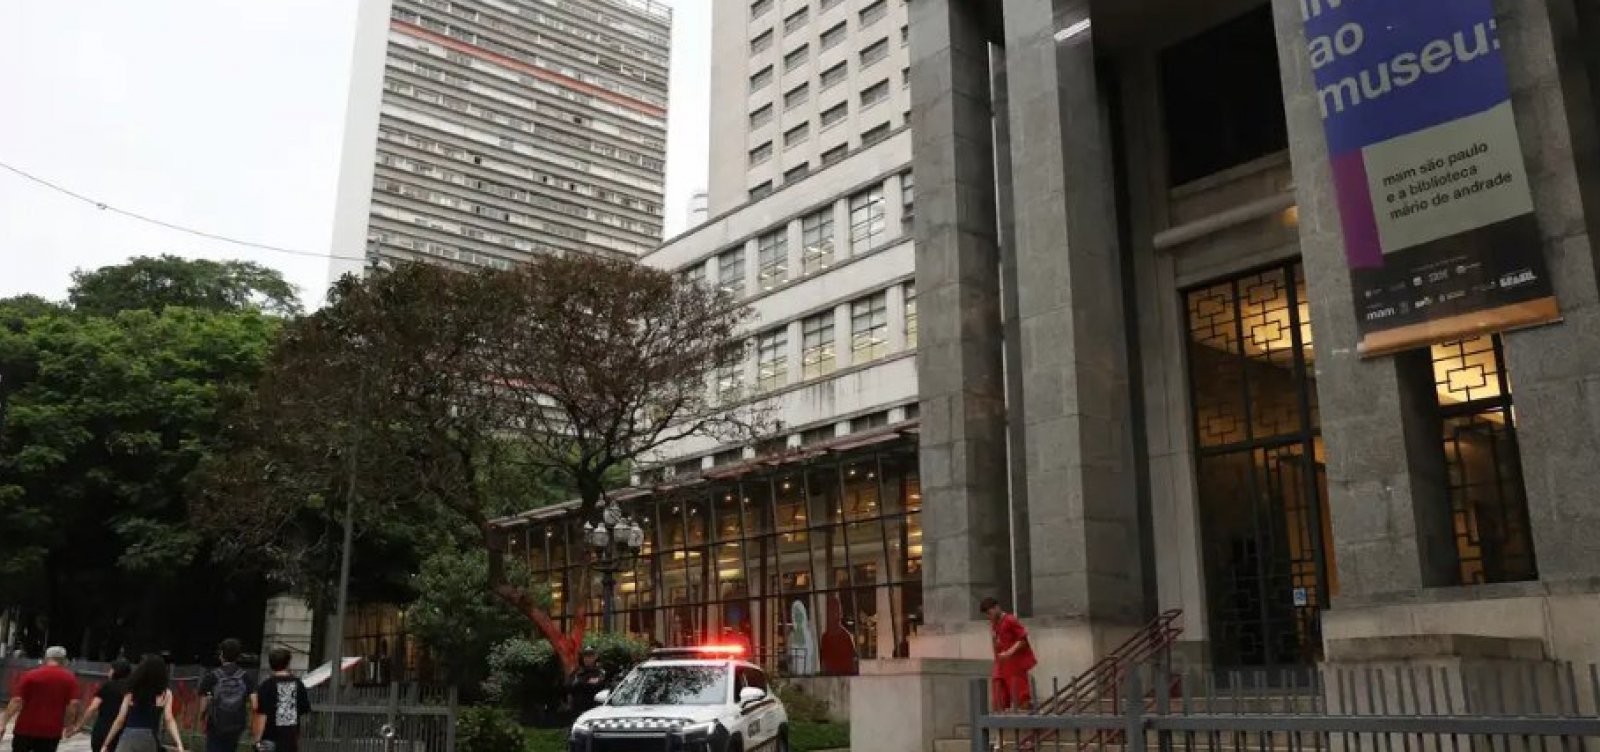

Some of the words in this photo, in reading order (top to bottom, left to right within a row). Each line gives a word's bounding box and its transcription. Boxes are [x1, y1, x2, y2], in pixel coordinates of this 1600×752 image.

[1308, 22, 1364, 69] ao
[1316, 18, 1500, 119] museu:
[1383, 168, 1416, 186] mam
[1420, 158, 1444, 173] são
[1448, 142, 1488, 166] paulo
[1387, 193, 1395, 203] e
[1398, 189, 1407, 199] a
[1409, 165, 1478, 195] biblioteca
[1432, 193, 1450, 206] de
[1453, 171, 1513, 200] andrade
